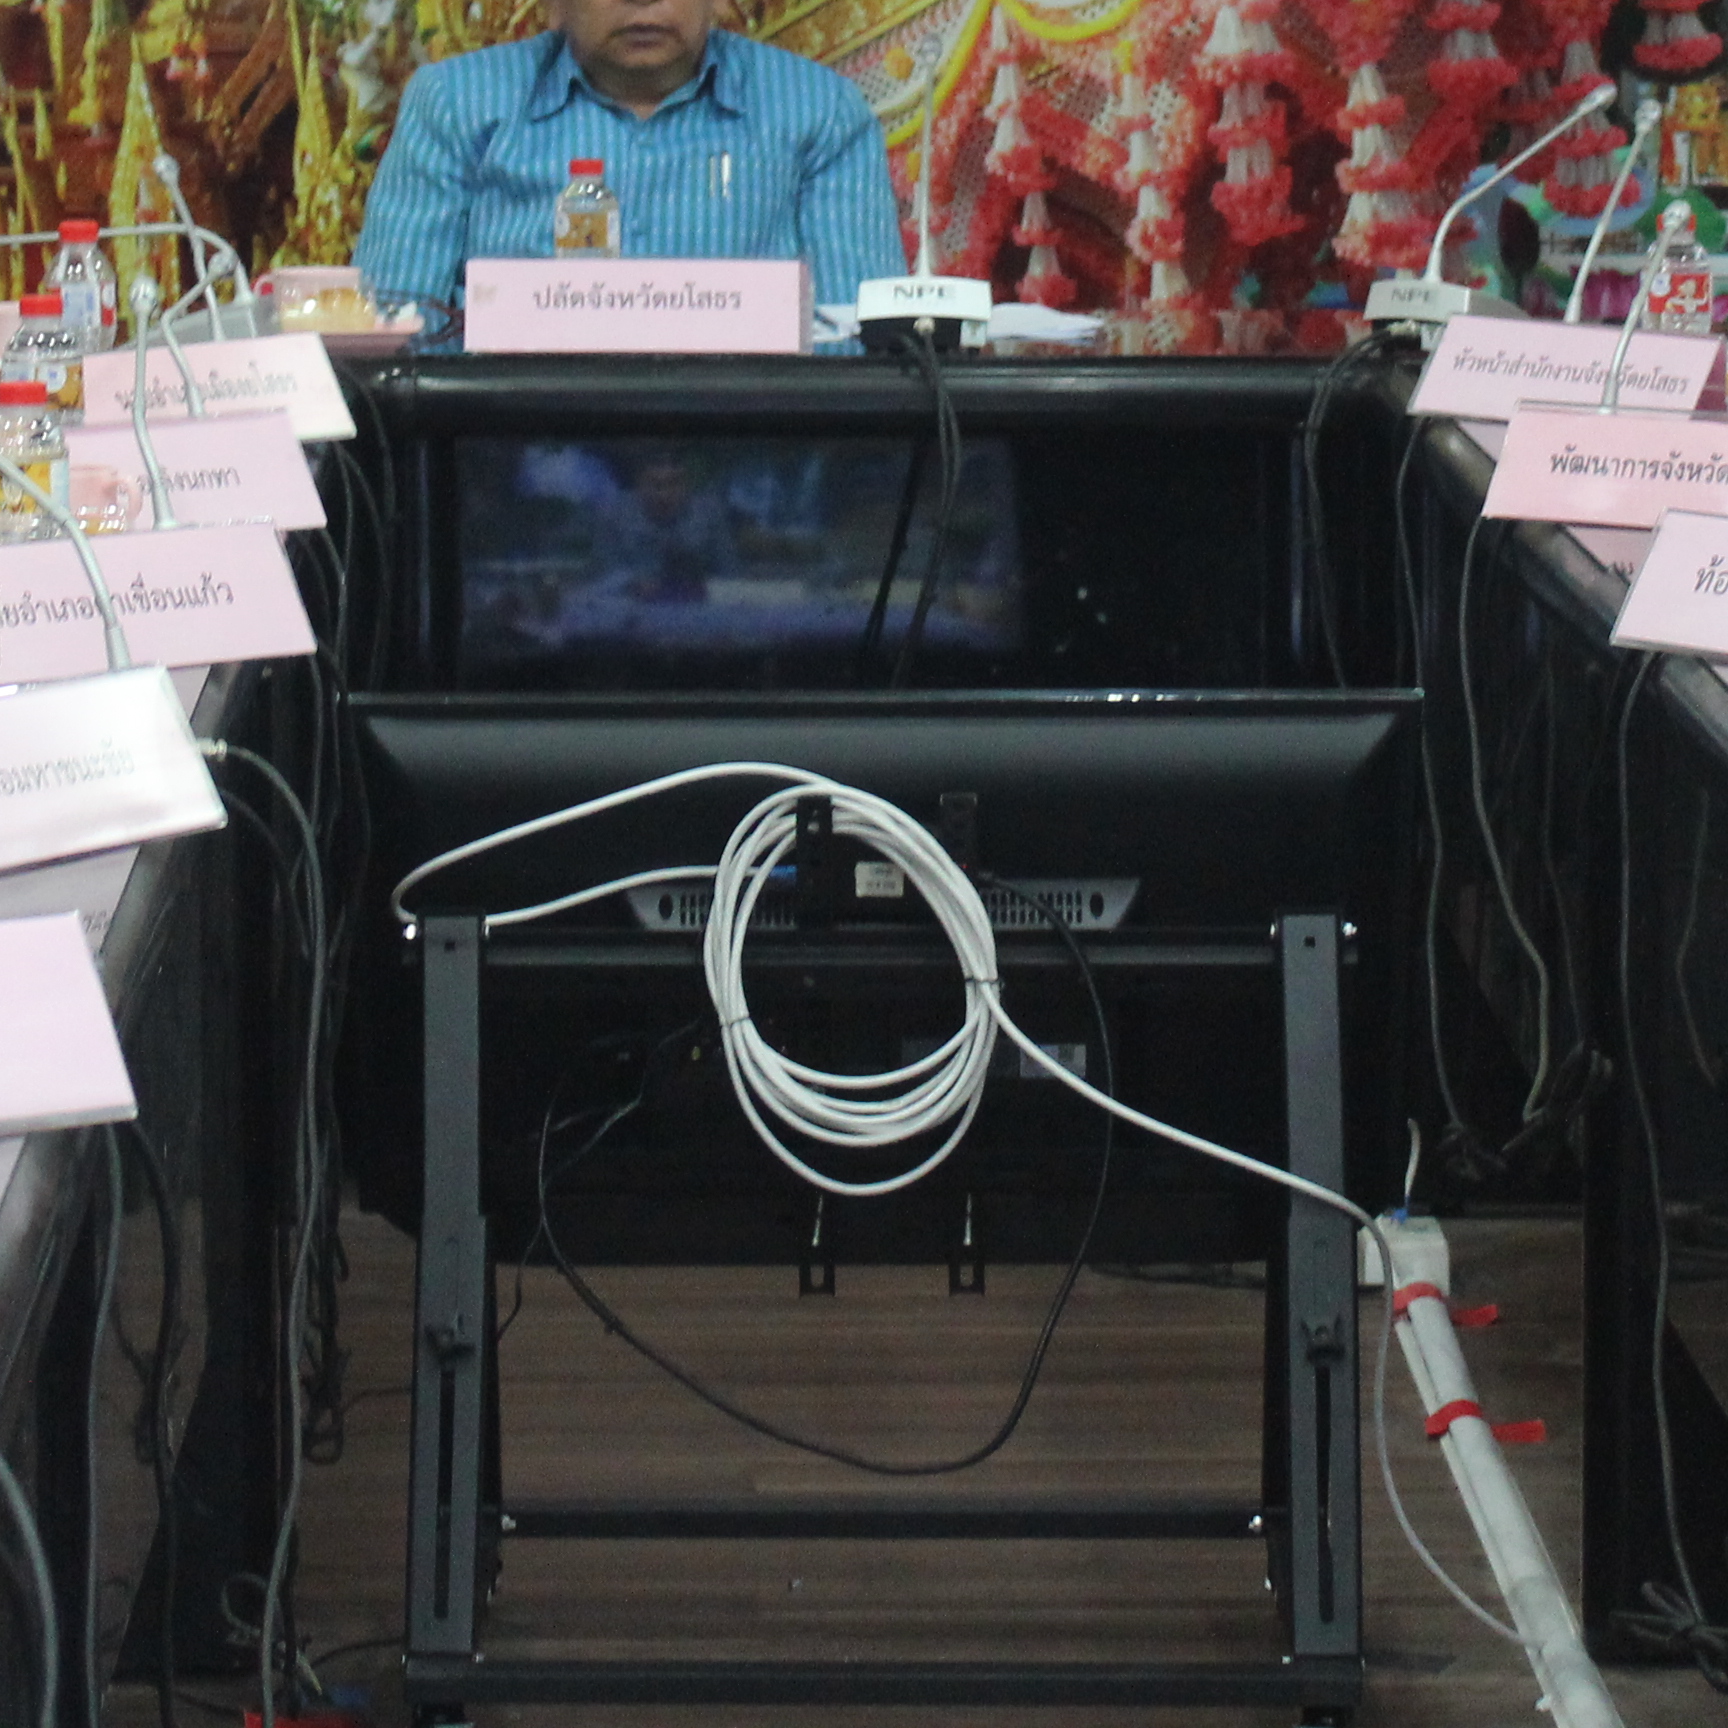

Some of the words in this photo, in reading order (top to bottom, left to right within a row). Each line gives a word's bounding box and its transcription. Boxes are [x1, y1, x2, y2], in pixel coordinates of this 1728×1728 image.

[531, 280, 743, 310] ปลัดจังหวัดยโสธร
[1452, 346, 1690, 395] หัวหน้าสำนักงานจังวัดยโสธร
